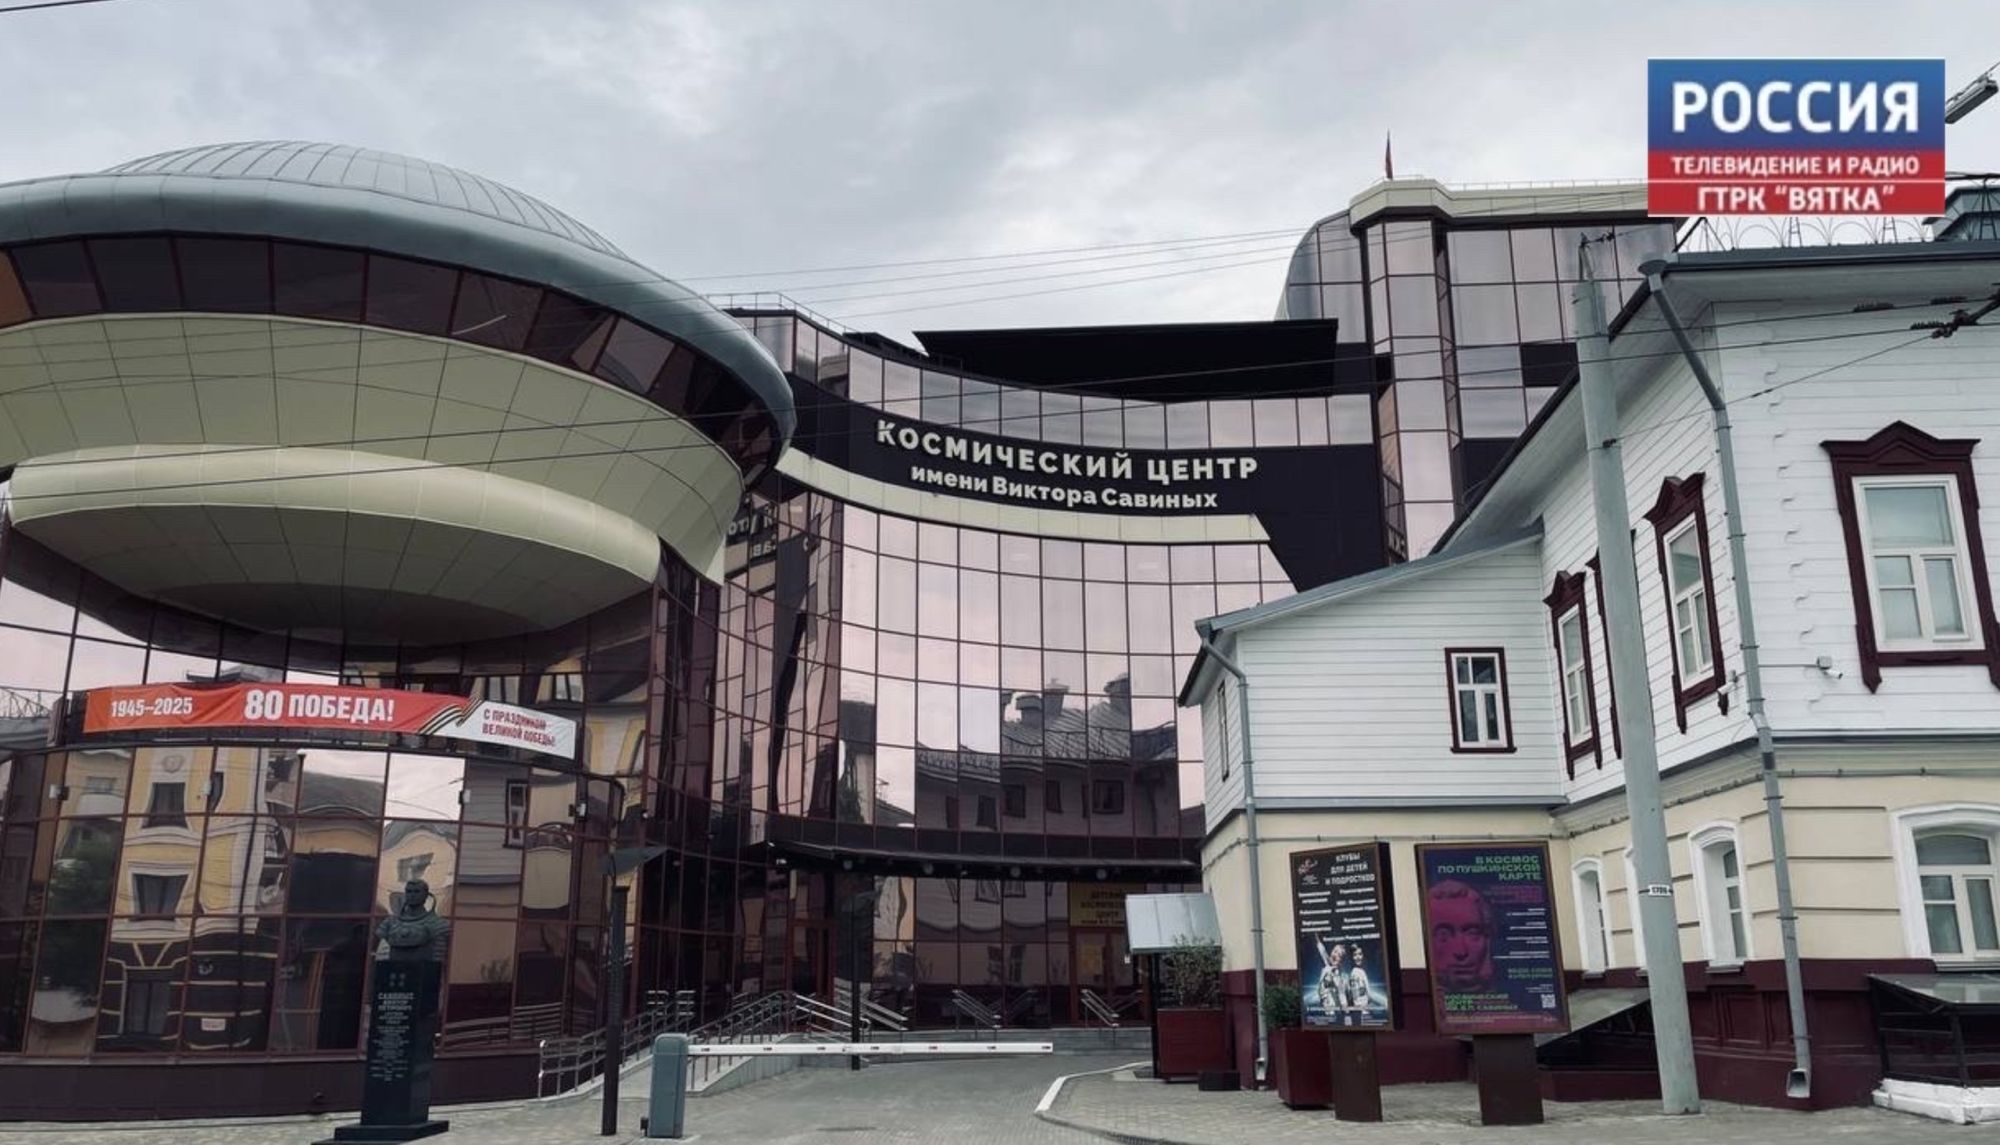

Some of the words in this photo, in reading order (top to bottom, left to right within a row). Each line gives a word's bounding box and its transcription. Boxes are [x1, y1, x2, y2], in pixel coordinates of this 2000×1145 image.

[876, 419, 1132, 479] КОСМИЧЕСКИЙ
[1147, 457, 1258, 485] ЦЕНТР
[911, 465, 988, 493] имени
[993, 477, 1097, 506] Виктора
[1101, 488, 1217, 509] Савиных
[244, 689, 283, 720] 80
[288, 693, 394, 724] ПОБЕДА!
[484, 709, 490, 720] С
[1438, 865, 1455, 873] ПО
[1456, 864, 1540, 873] ПУШКИНСКОЙ
[1486, 855, 1540, 864] КОСМОС
